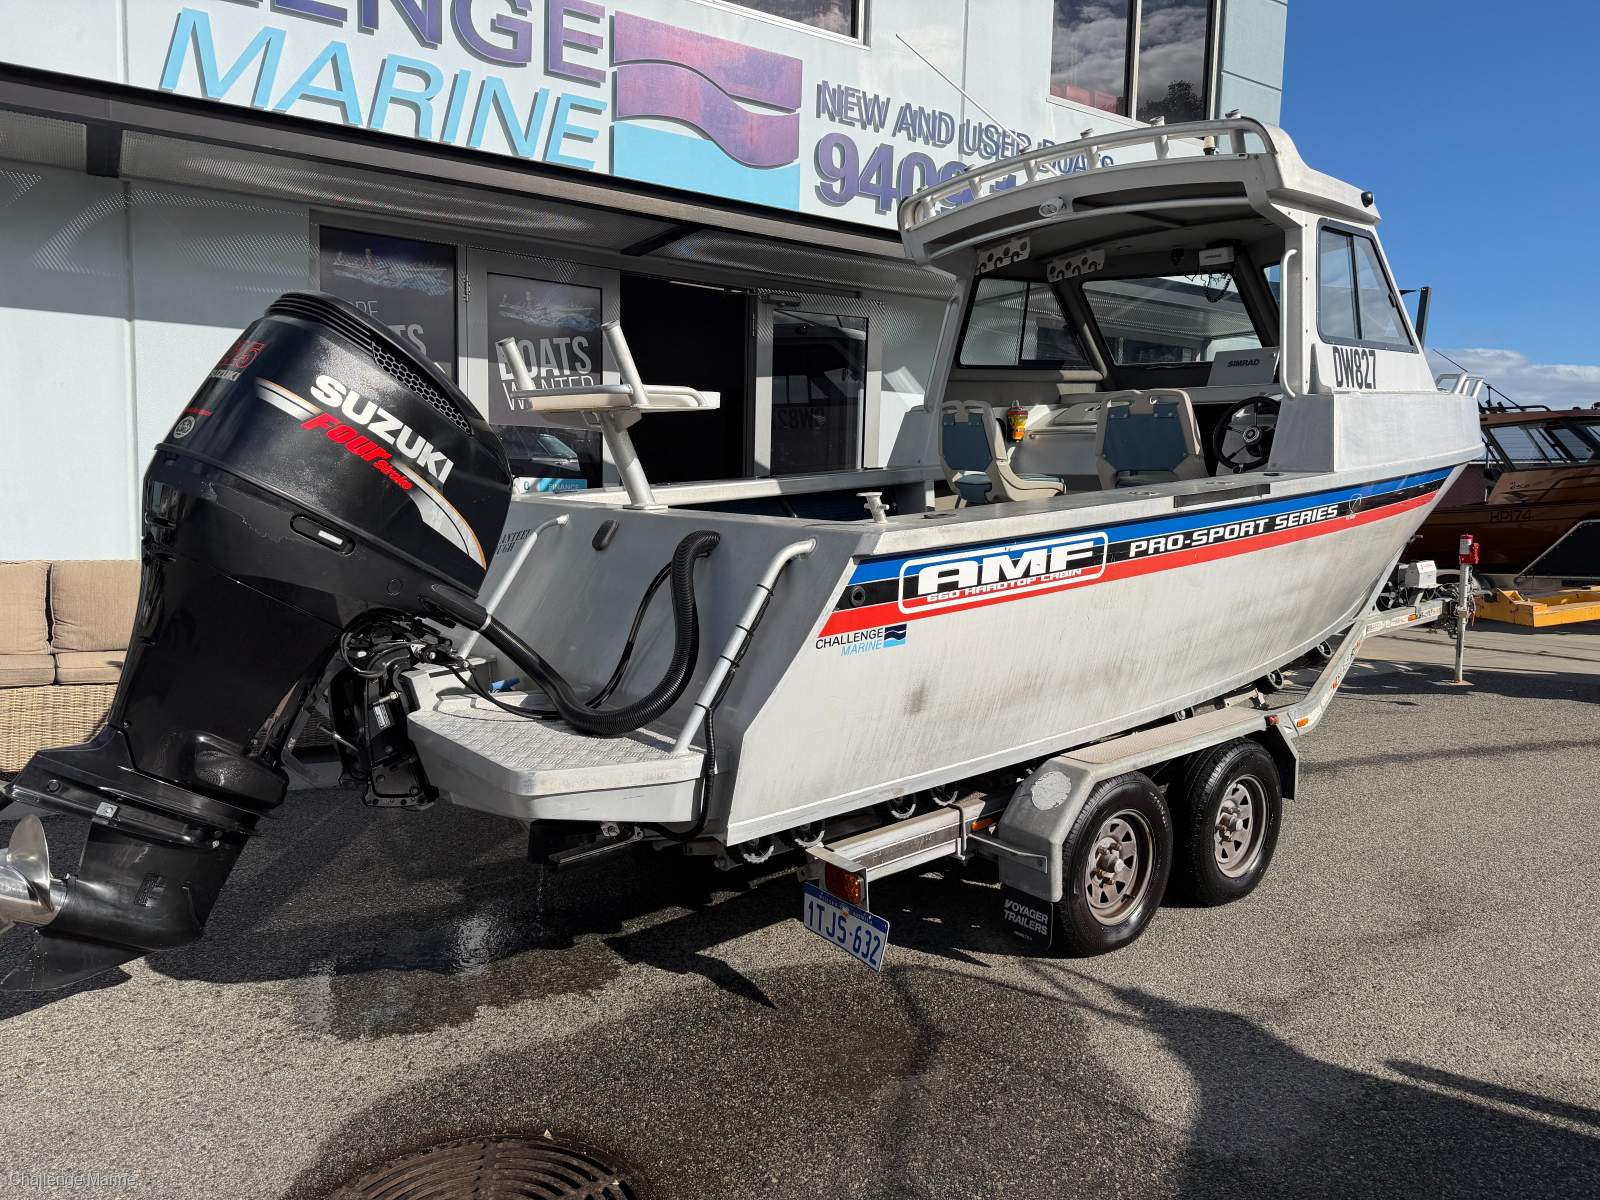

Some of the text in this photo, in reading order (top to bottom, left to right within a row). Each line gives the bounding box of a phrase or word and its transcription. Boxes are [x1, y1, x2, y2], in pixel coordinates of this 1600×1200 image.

[158, 7, 608, 170] MARINE
[815, 79, 891, 134] NEW
[891, 102, 956, 149] AND
[1227, 358, 1260, 368] SIMRAD
[1333, 345, 1377, 389] DW827
[310, 374, 454, 484] SUZUKI
[1129, 505, 1338, 558] PRO-SPORT SERIES
[917, 541, 1095, 596] AMF
[926, 568, 1084, 603] 660 HARDTOP CABIN
[815, 628, 884, 650] CHALLENGE
[841, 640, 883, 657] MARINE
[1003, 911, 1048, 936] TRAILERS
[1004, 899, 1049, 925] VOYAGER
